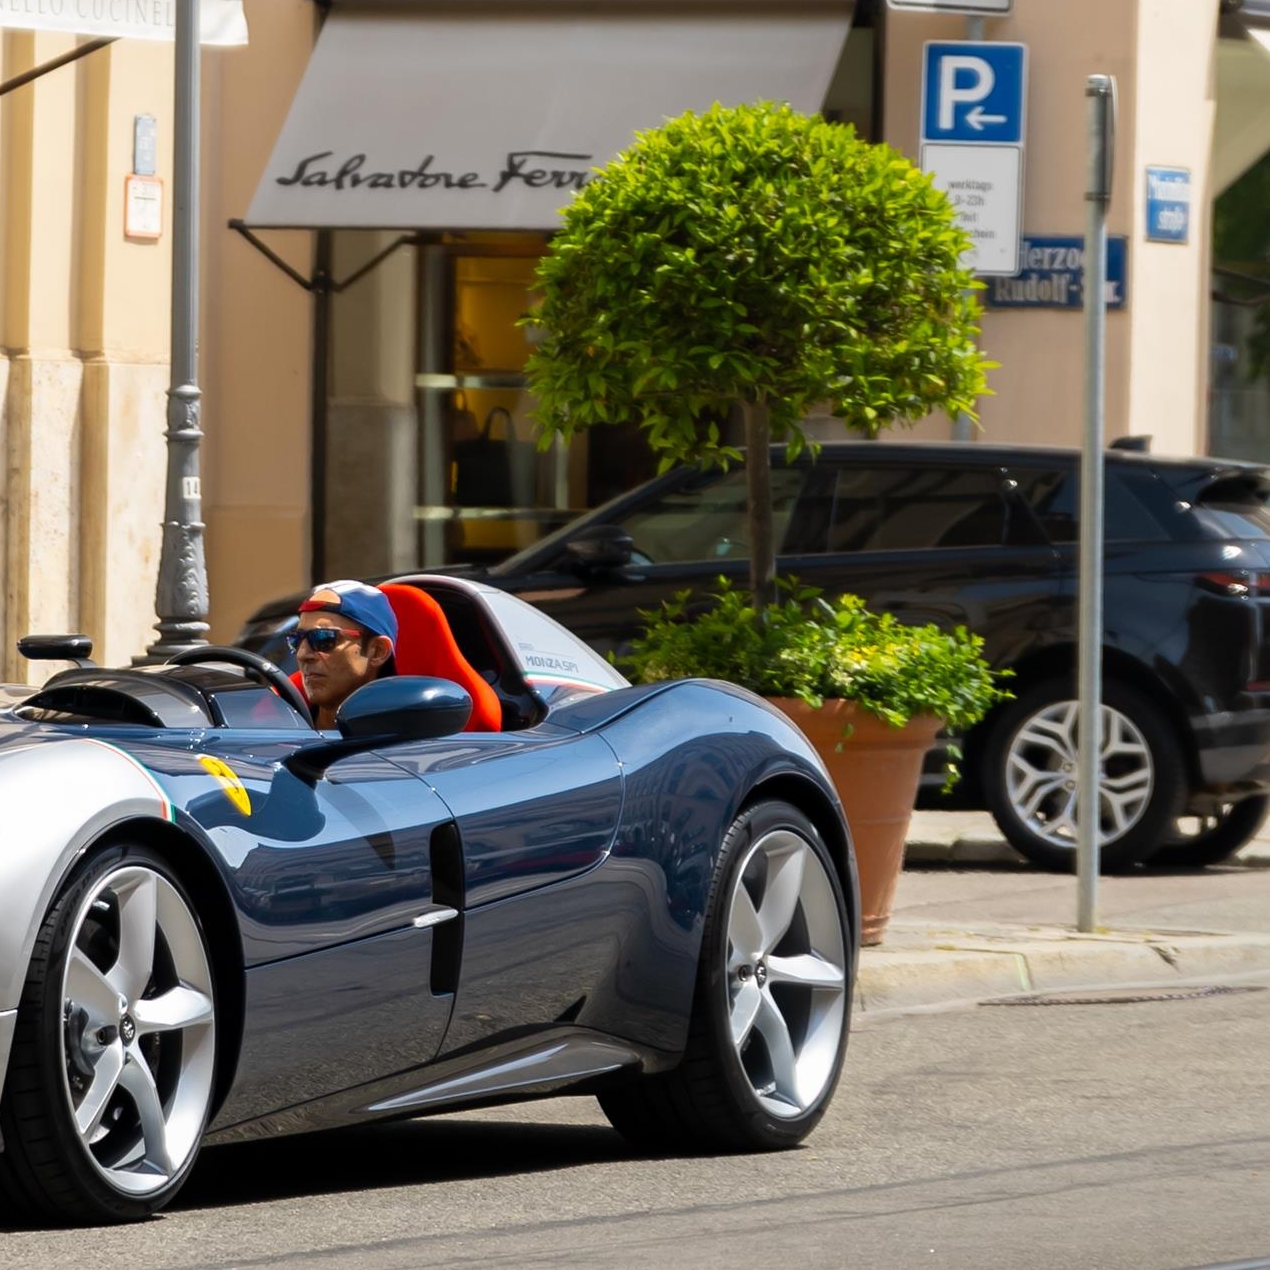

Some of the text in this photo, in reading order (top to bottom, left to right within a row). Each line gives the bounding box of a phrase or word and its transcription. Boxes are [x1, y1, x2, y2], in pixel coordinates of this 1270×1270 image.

[939, 55, 995, 130] P
[276, 151, 598, 192] Salvatore Ferr
[1021, 241, 1085, 270] erzo
